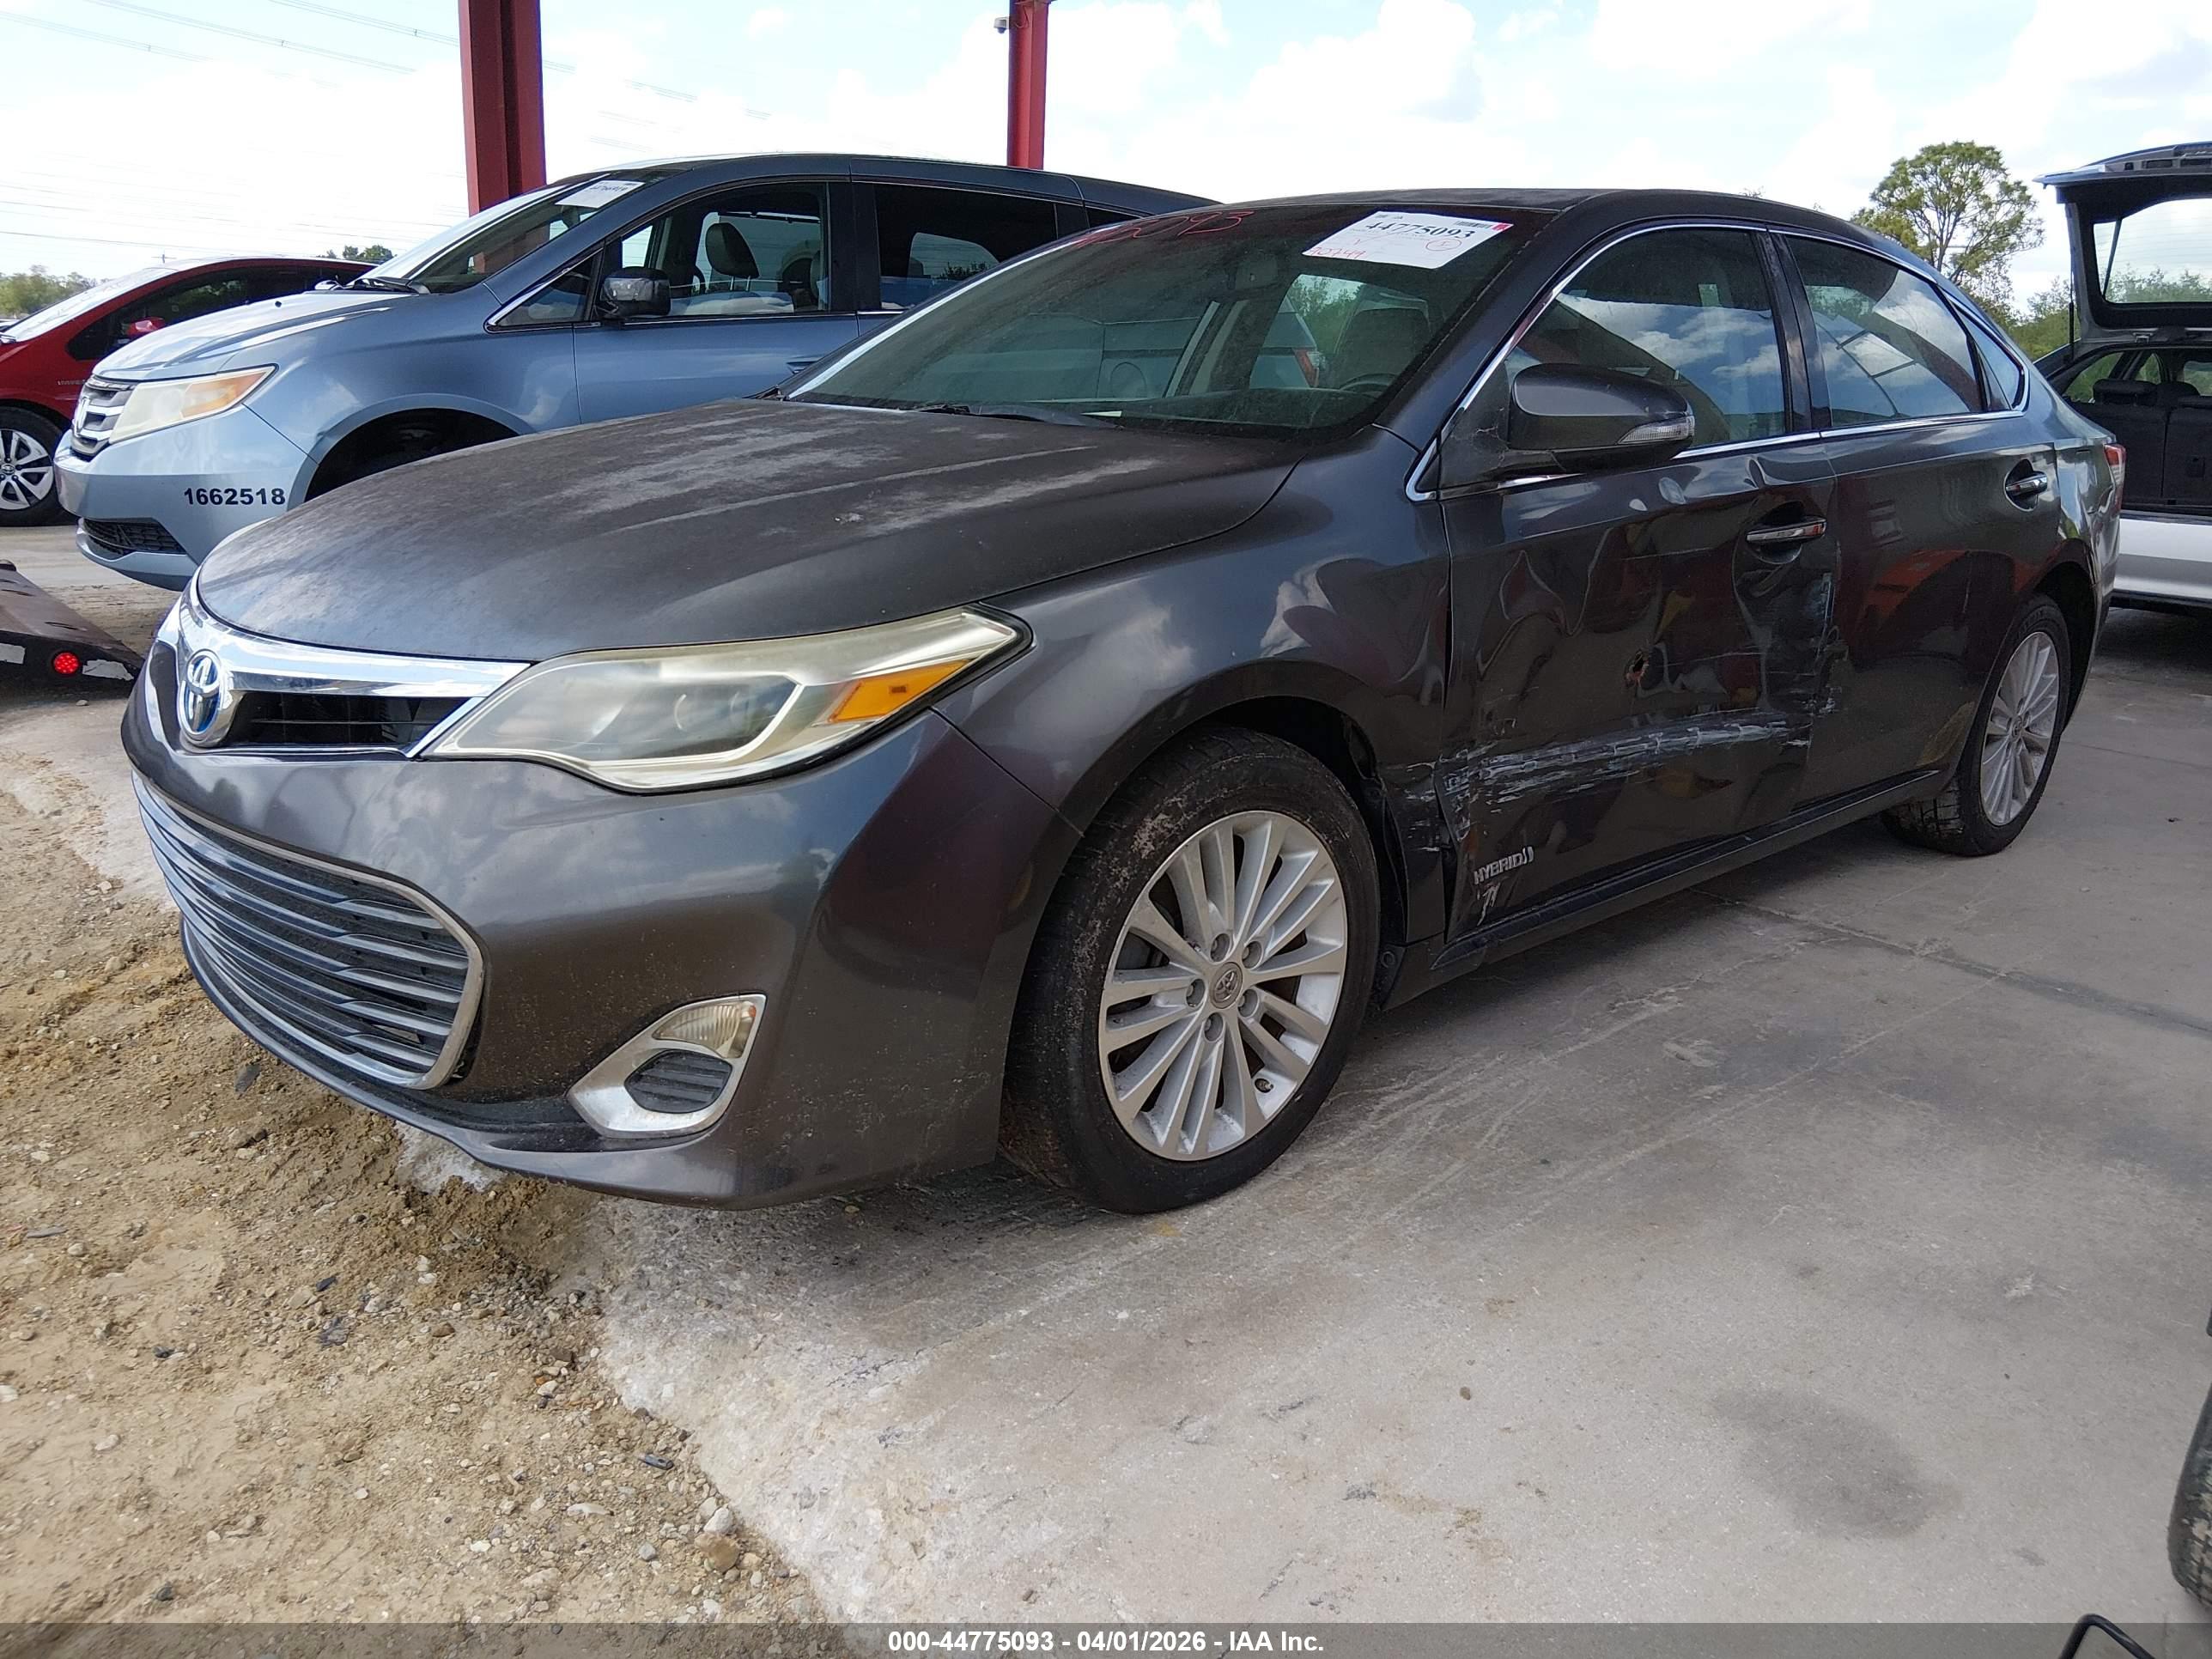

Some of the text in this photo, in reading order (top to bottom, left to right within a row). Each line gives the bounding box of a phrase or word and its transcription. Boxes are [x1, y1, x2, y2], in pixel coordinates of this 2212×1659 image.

[1365, 221, 1476, 240] 44775093
[184, 487, 286, 506] 1662518
[1474, 852, 1524, 885] HYBRID
